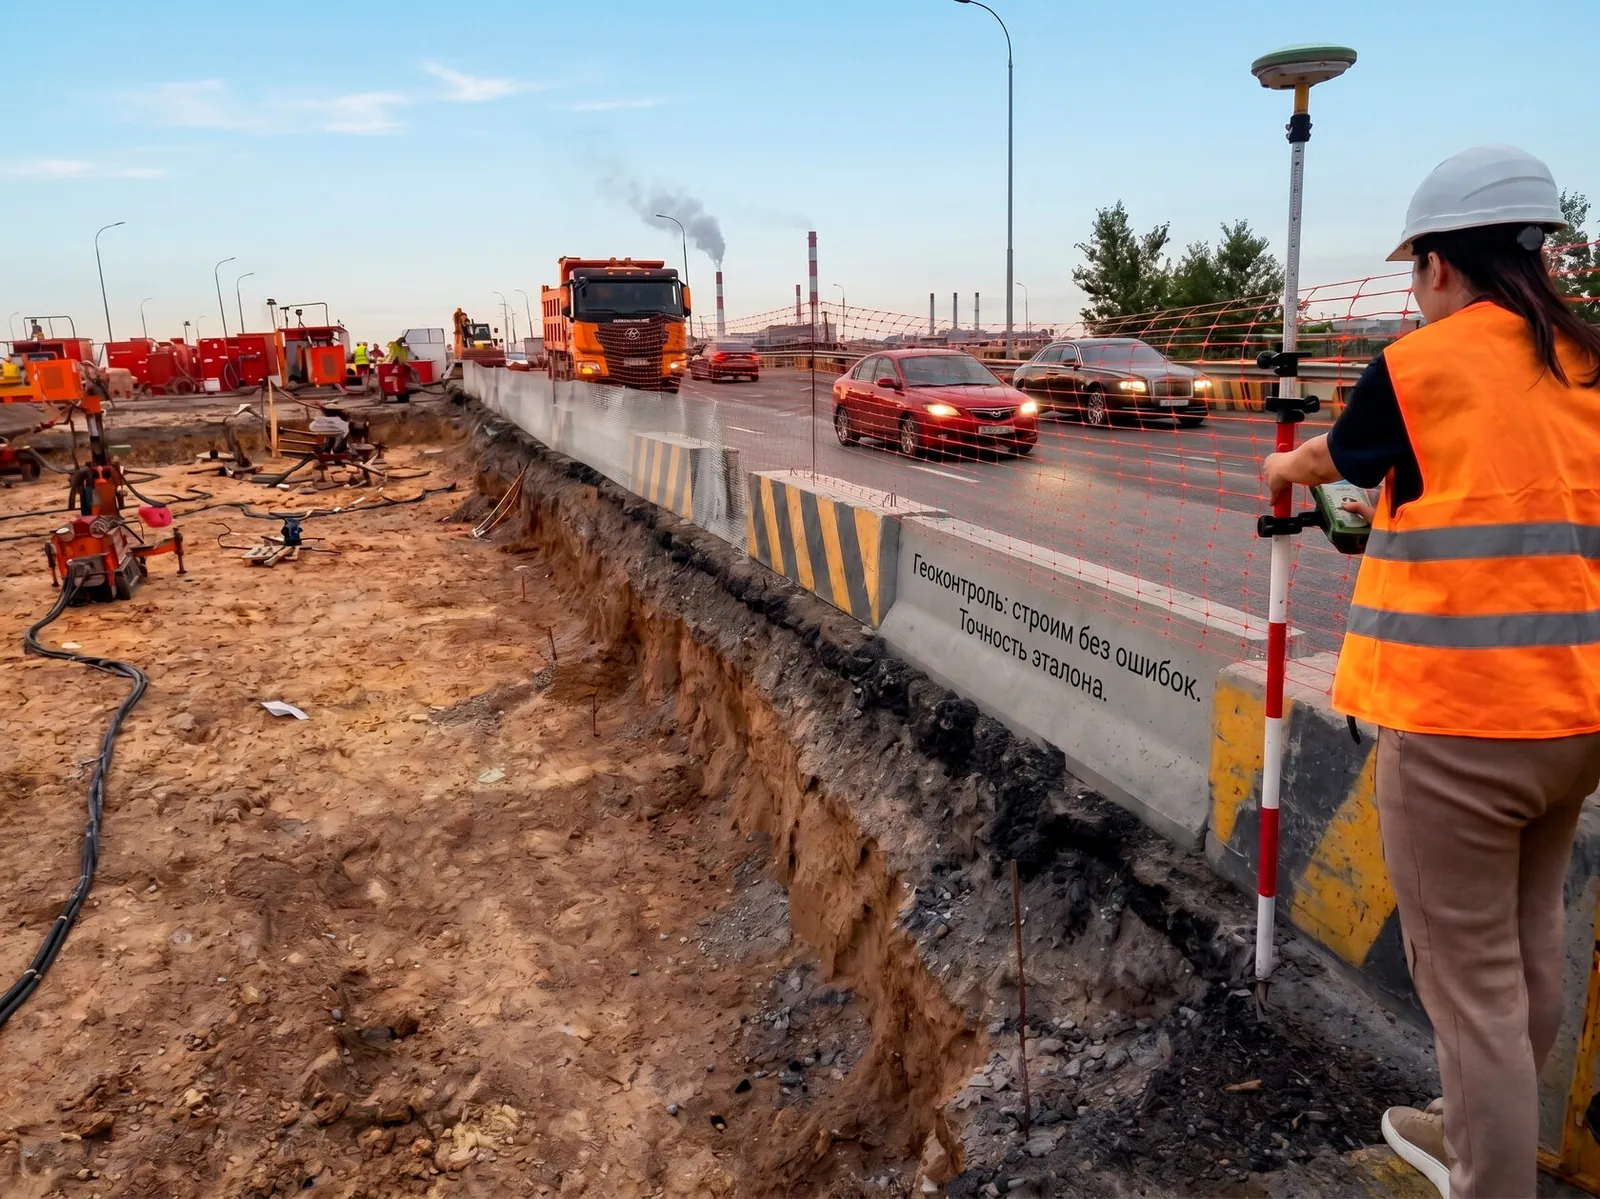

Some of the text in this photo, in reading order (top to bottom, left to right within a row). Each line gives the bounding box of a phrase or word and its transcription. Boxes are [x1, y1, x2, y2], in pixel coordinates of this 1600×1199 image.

[913, 552, 1201, 703] Геоконтроль: строим без ошибок.
[959, 607, 1108, 702] Точность эталона.
